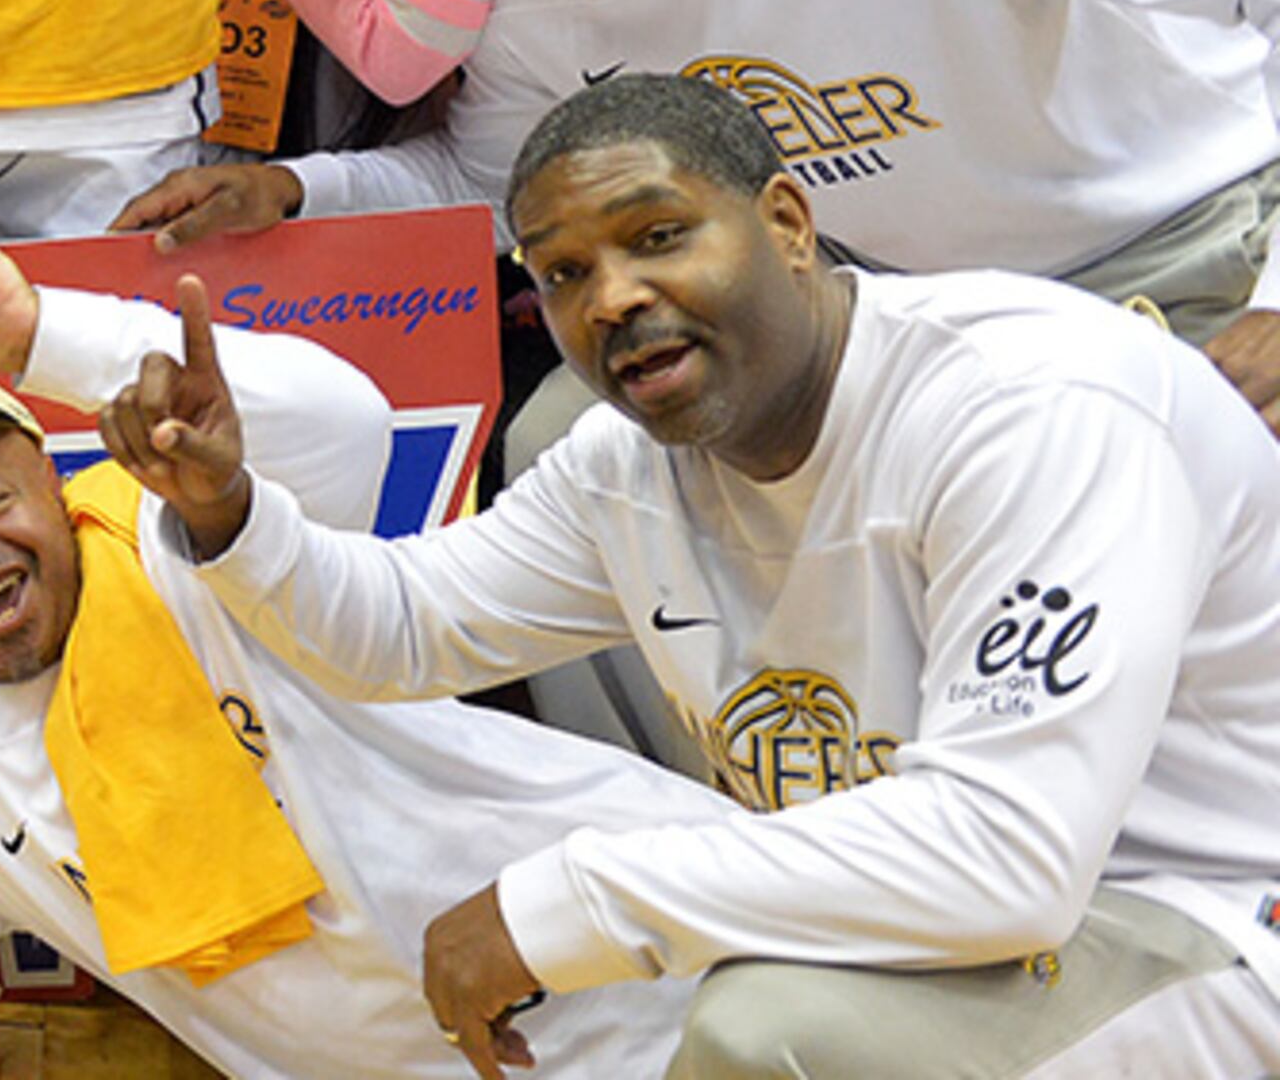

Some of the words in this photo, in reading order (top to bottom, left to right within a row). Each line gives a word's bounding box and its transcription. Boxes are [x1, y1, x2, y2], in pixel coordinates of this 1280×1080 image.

[750, 74, 943, 162] ELER
[791, 148, 893, 187] TBALL
[222, 282, 480, 335] Swearngin
